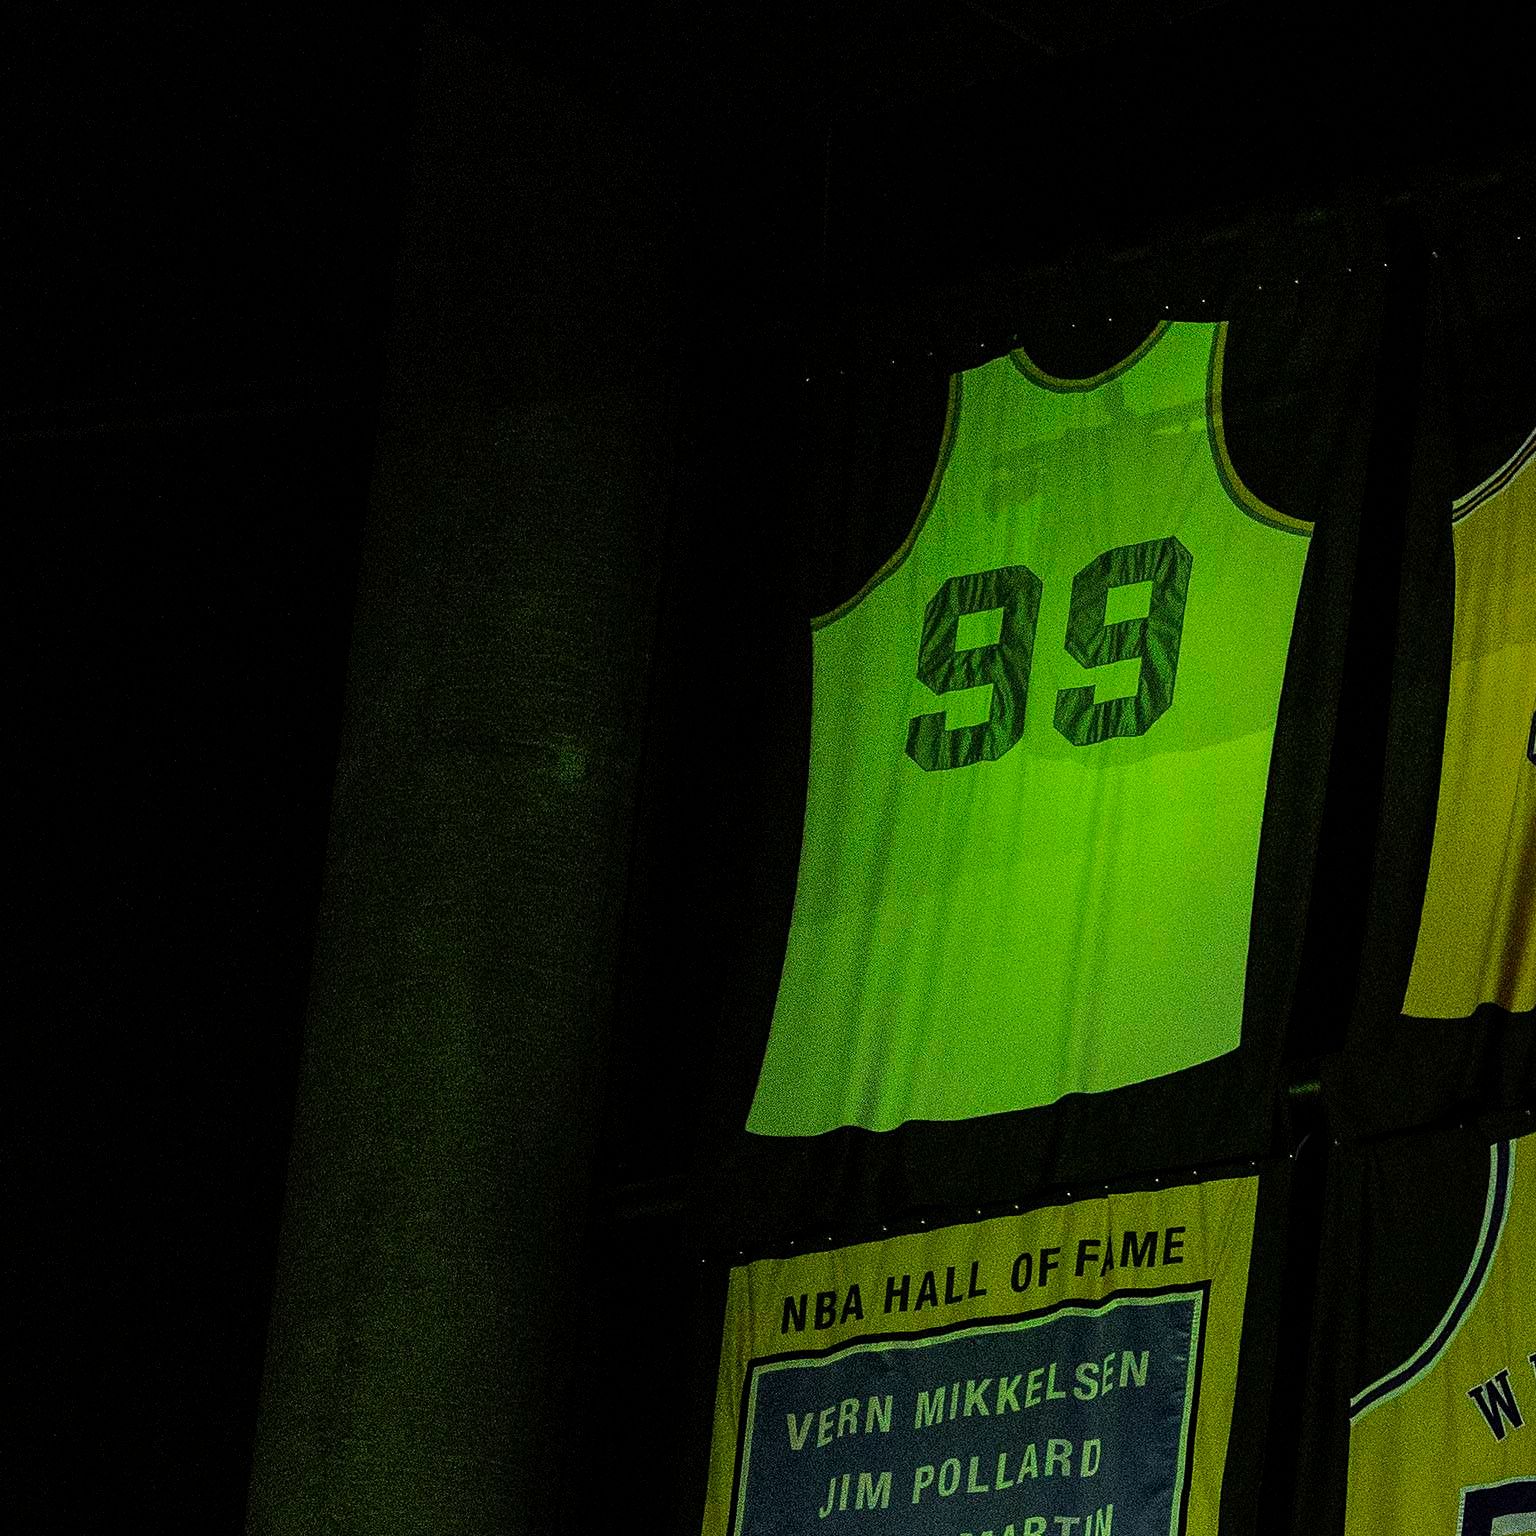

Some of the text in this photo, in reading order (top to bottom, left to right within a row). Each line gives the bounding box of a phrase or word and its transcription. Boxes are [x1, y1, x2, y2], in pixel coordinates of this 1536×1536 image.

[906, 535, 1194, 772] 99
[780, 1227, 1186, 1334] NBA HALL OF FAME
[786, 1350, 1150, 1451] VERN MIKKELSEN
[818, 1438, 1101, 1520] JIM POLLARD
